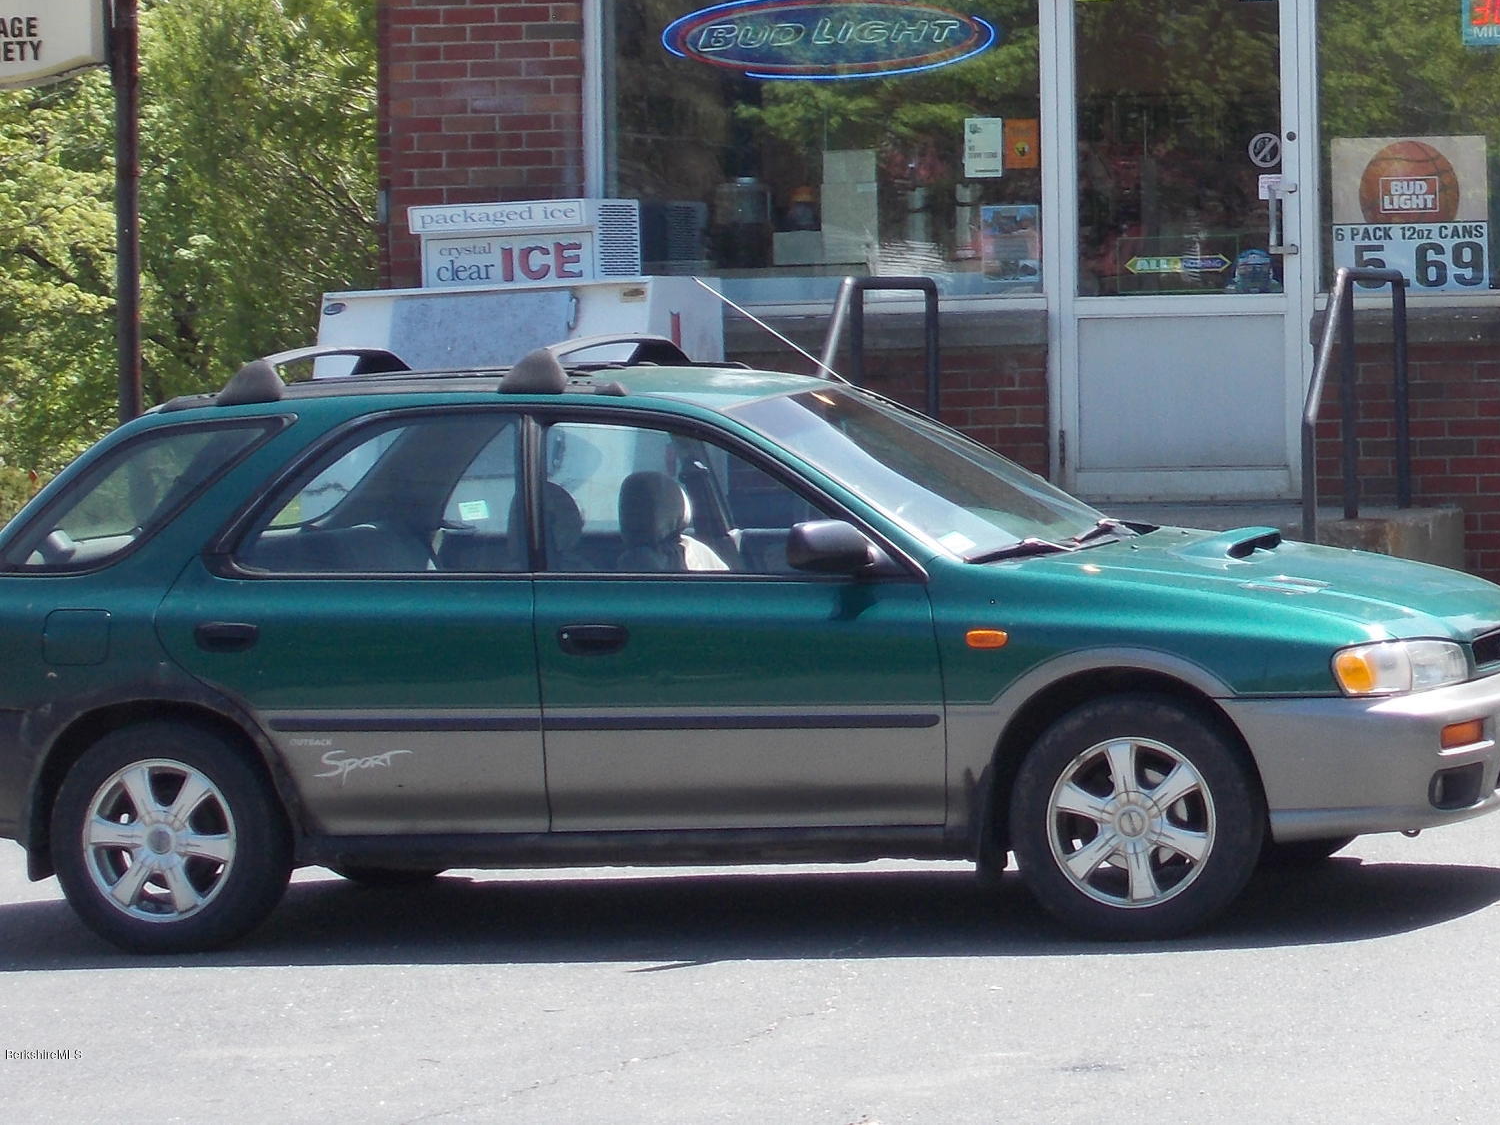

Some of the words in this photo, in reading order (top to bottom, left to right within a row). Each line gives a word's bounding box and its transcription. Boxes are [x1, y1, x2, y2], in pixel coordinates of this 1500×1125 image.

[698, 24, 805, 51] BUD
[812, 18, 960, 44] LIGHT
[1390, 180, 1428, 195] BUD
[1383, 194, 1435, 210] LIGHT
[420, 206, 533, 228] packaged
[543, 206, 576, 220] ice
[1334, 227, 1345, 242] 6
[1350, 226, 1393, 241] PACK
[1438, 225, 1484, 240] CANS
[439, 242, 492, 259] crystal
[500, 242, 583, 282] ICE
[436, 260, 495, 282] clear
[289, 738, 333, 747] OUTBACK
